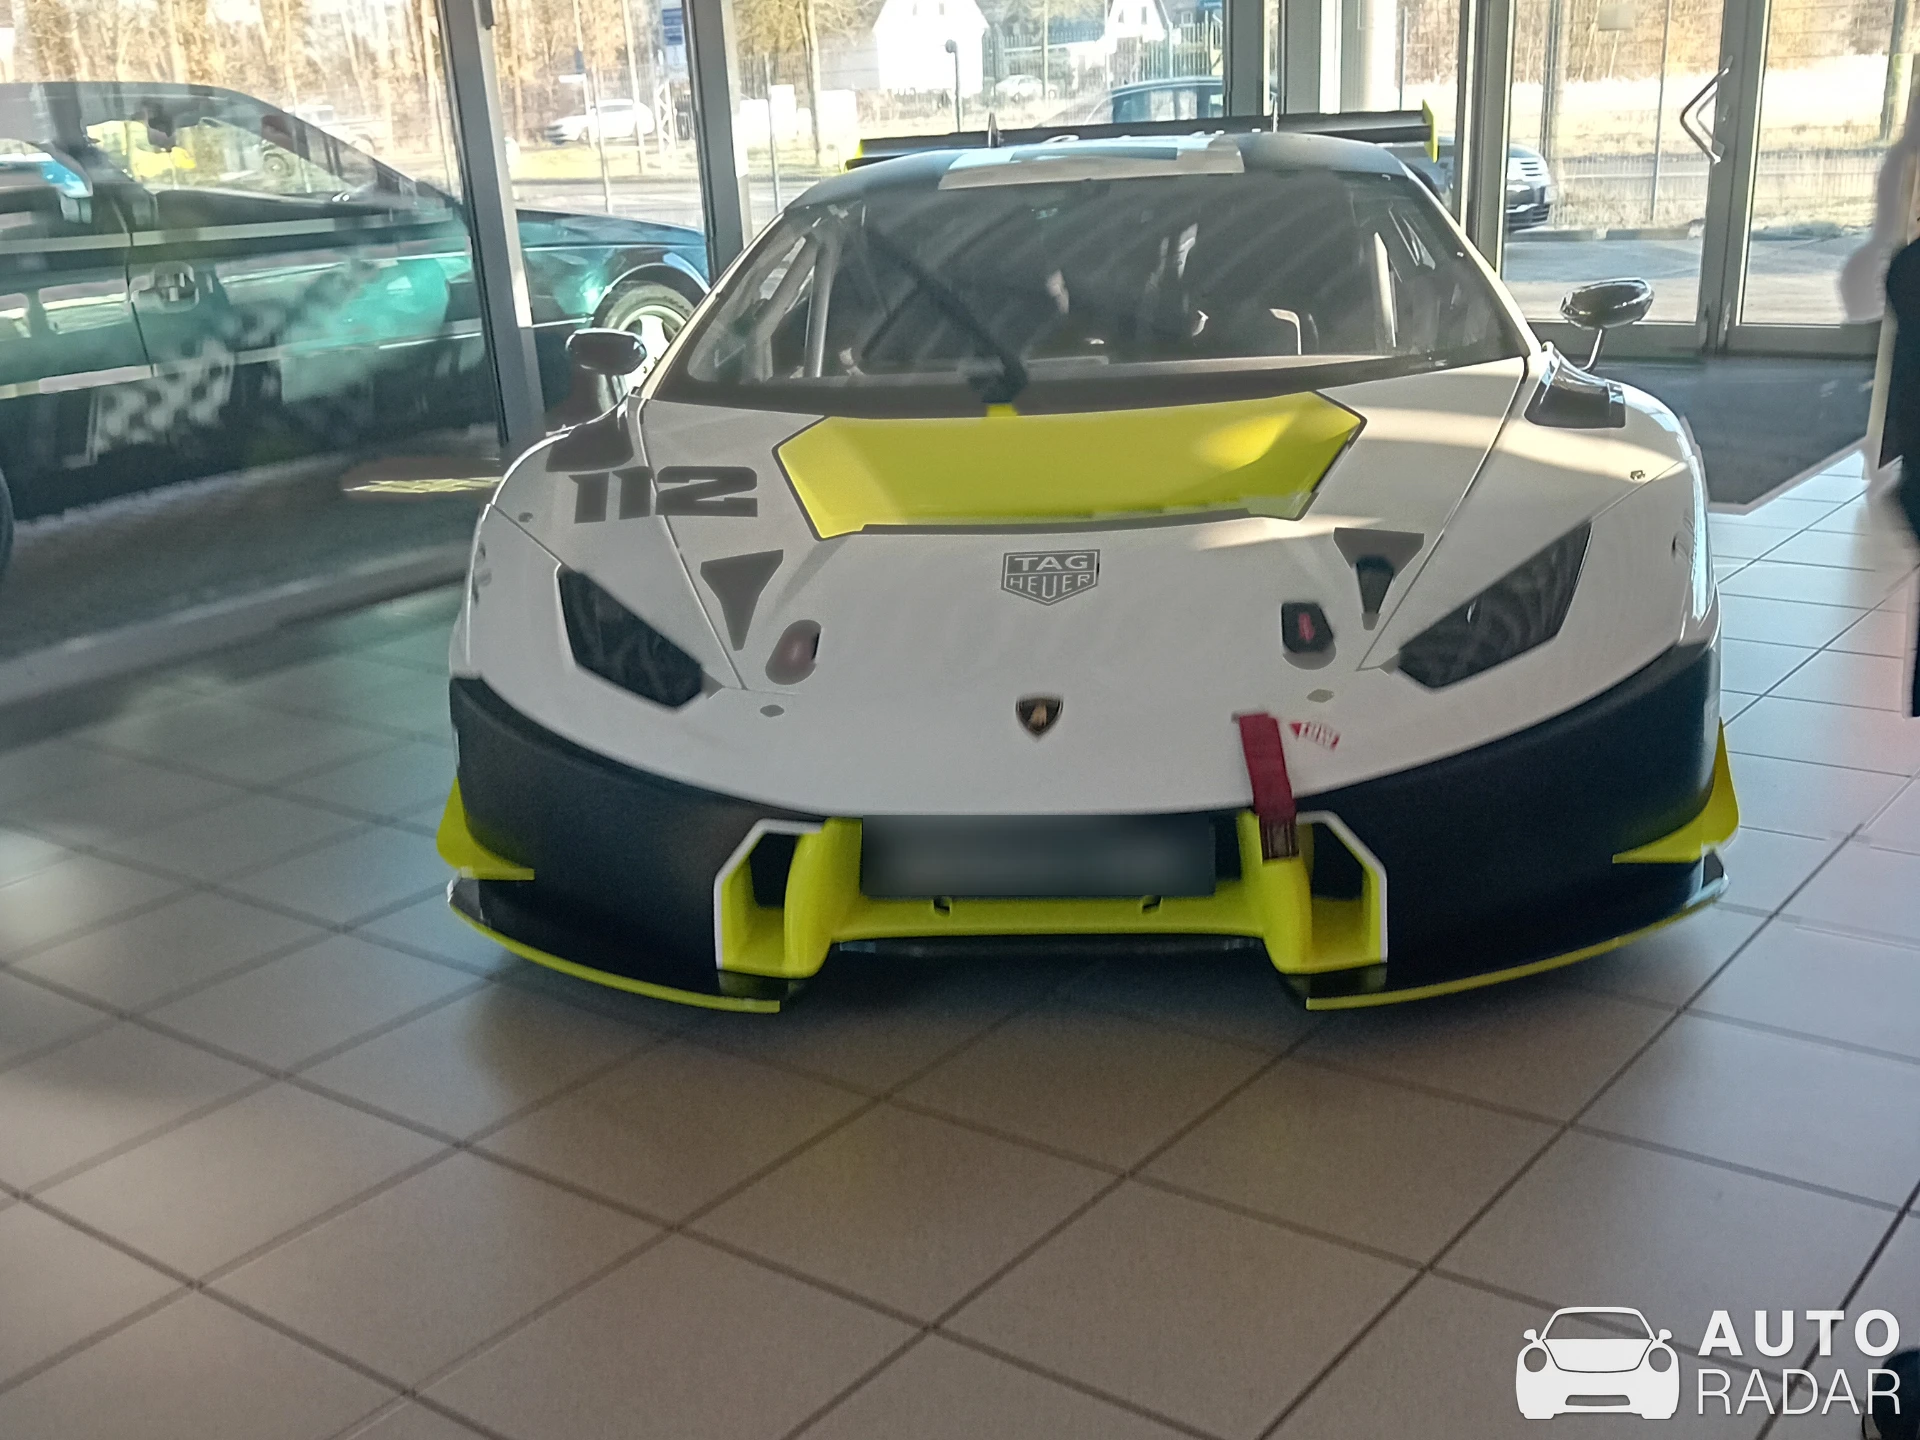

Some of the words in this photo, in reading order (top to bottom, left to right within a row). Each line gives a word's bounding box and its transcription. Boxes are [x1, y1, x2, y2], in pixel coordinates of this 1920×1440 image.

[568, 466, 758, 524] 112
[1014, 555, 1088, 571] TAG
[1010, 574, 1090, 599] HEUER
